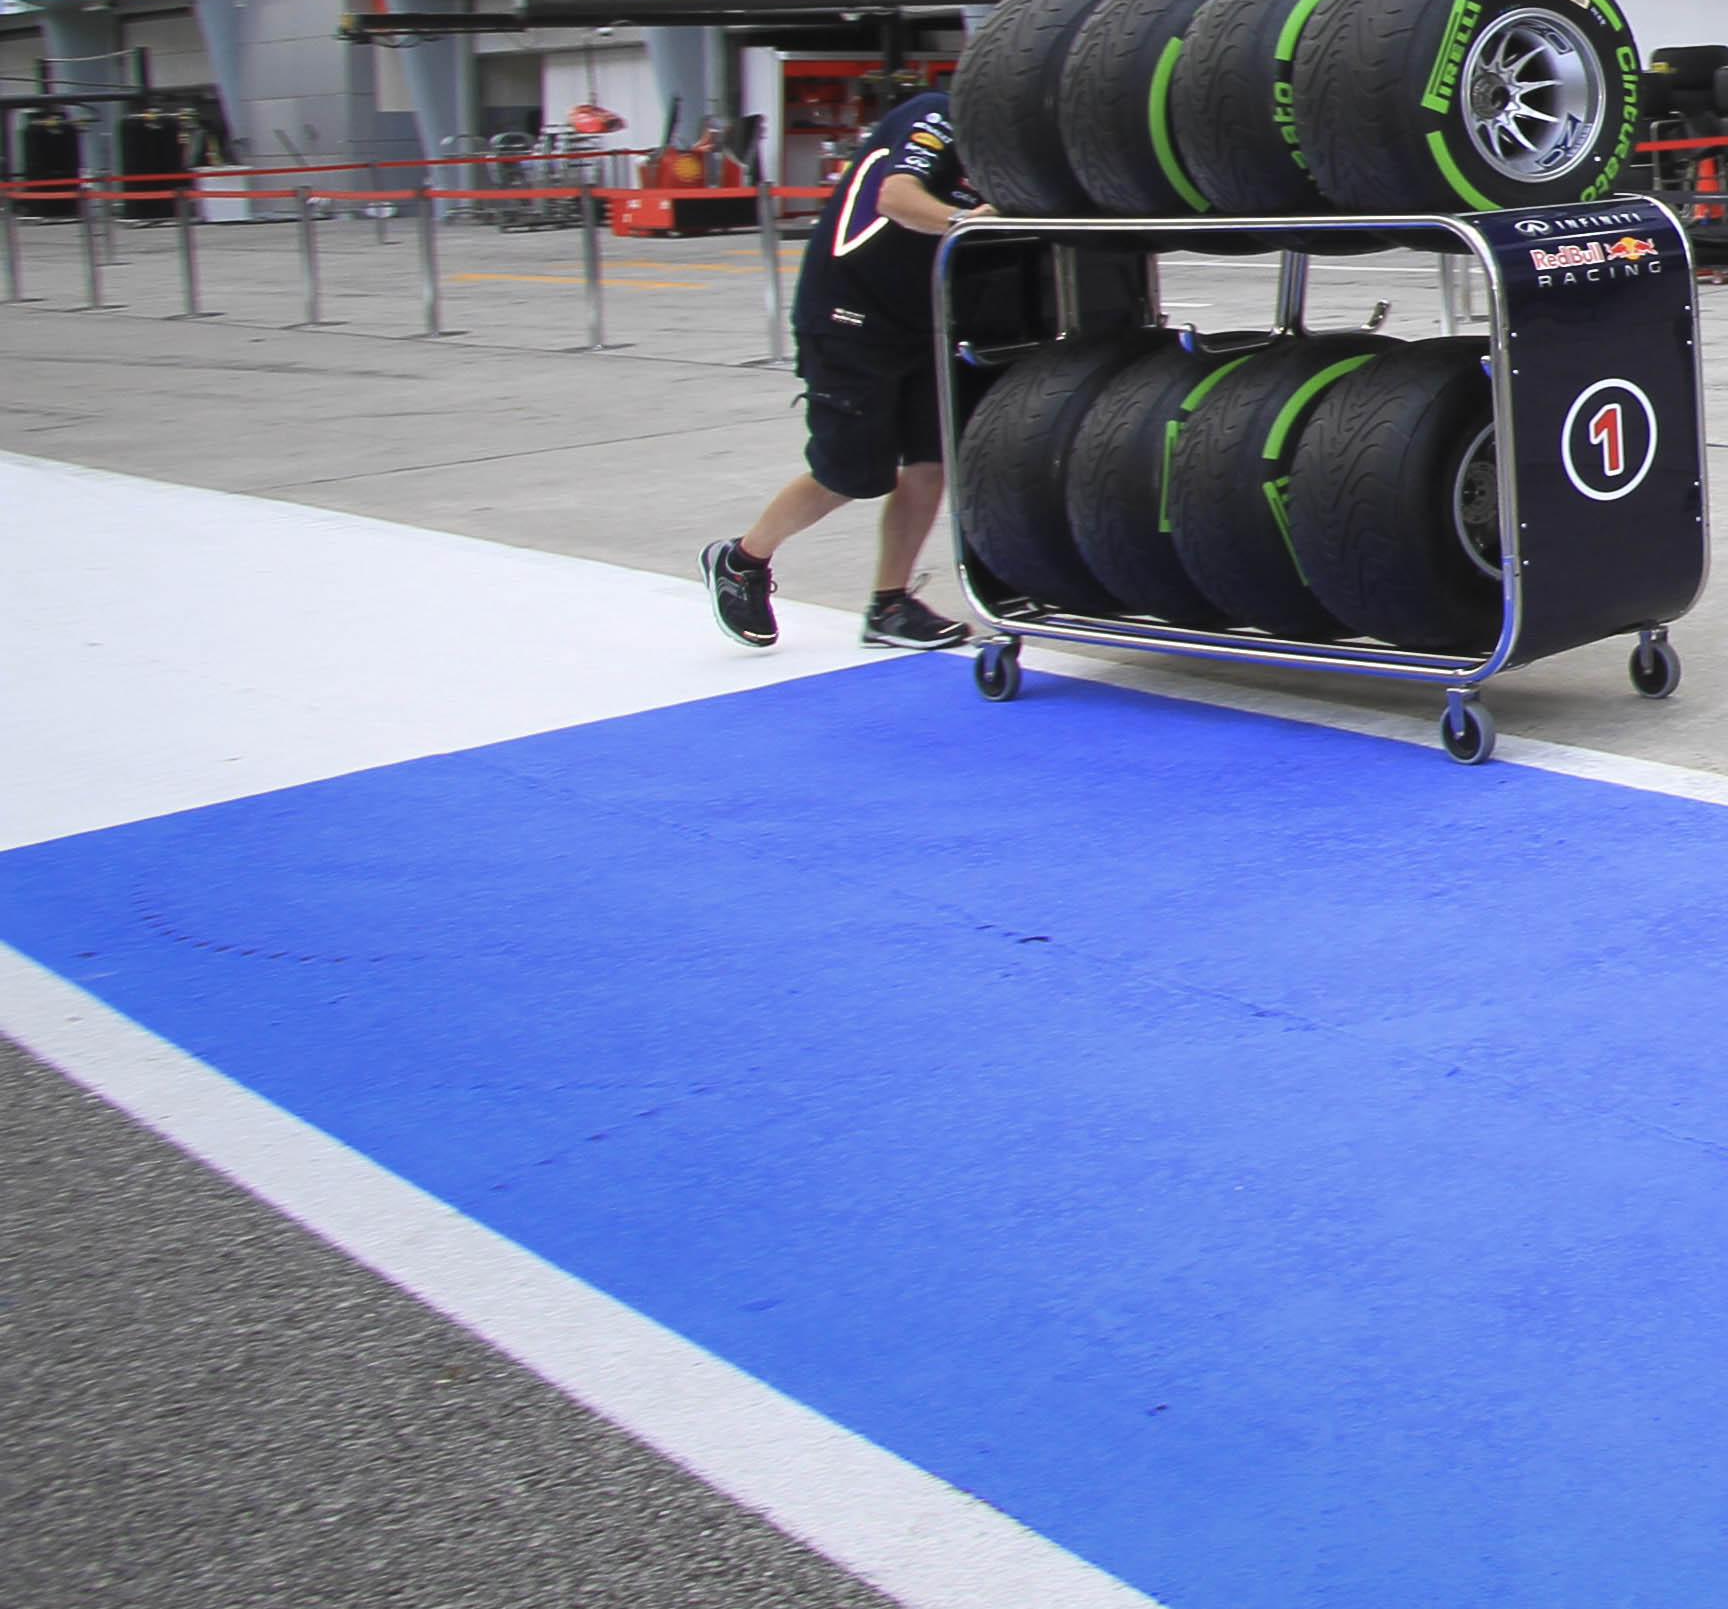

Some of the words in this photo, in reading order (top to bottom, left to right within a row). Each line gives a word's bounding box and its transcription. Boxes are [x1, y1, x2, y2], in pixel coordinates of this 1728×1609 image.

[1554, 212, 1643, 231] INFINITI
[1537, 260, 1663, 289] RACING
[1589, 403, 1625, 477] 1
